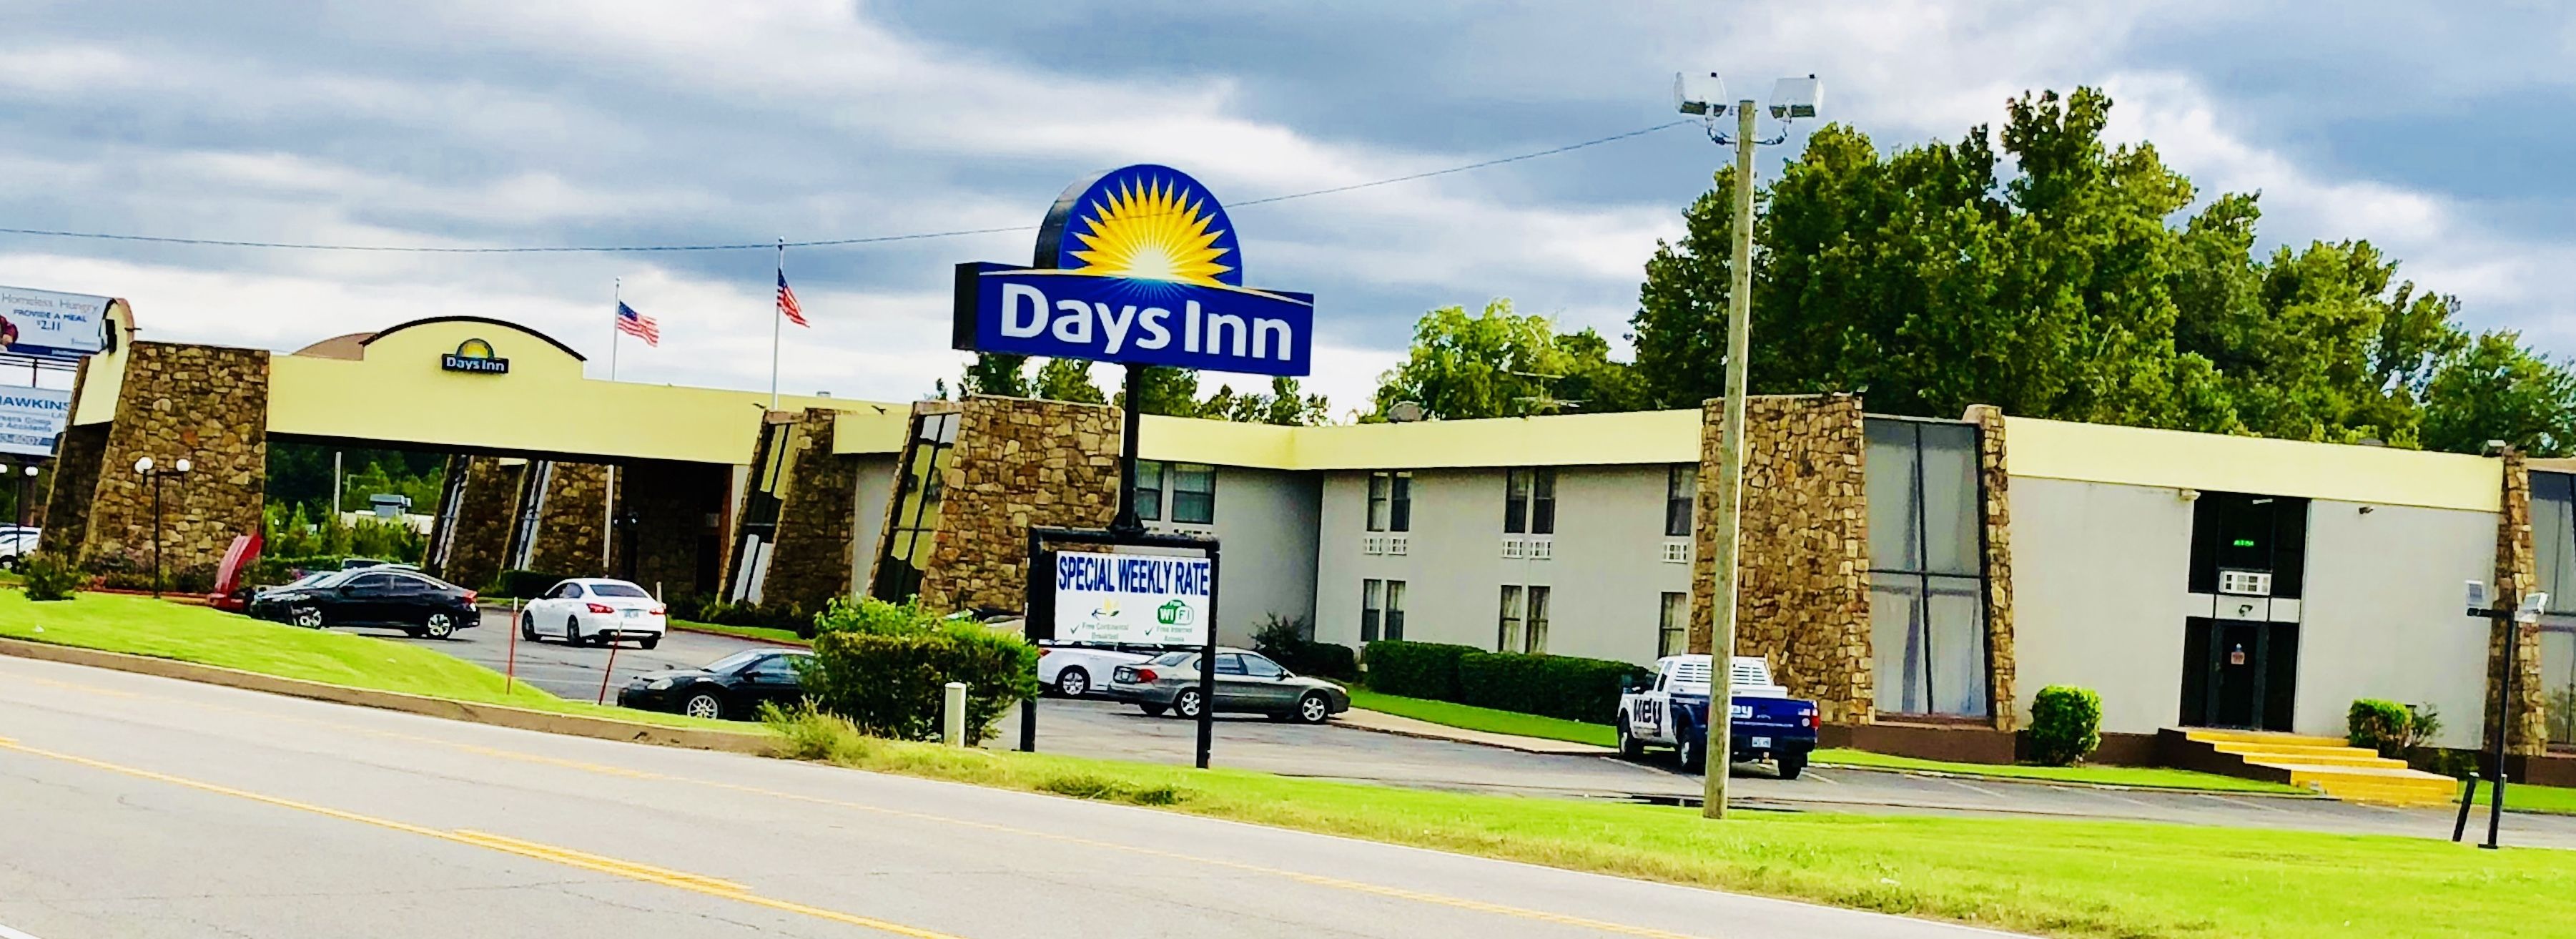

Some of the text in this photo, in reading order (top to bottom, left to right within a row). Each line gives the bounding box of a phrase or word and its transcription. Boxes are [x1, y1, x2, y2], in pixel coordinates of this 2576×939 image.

[2, 293, 99, 314] Homeless Hungry
[14, 309, 51, 319] PROVIDE
[1001, 283, 1292, 361] Days Inn
[446, 357, 505, 372] Days Inn
[1058, 556, 1209, 596] SPECIAL WEEKLY RATE
[1097, 622, 1129, 631] Continental
